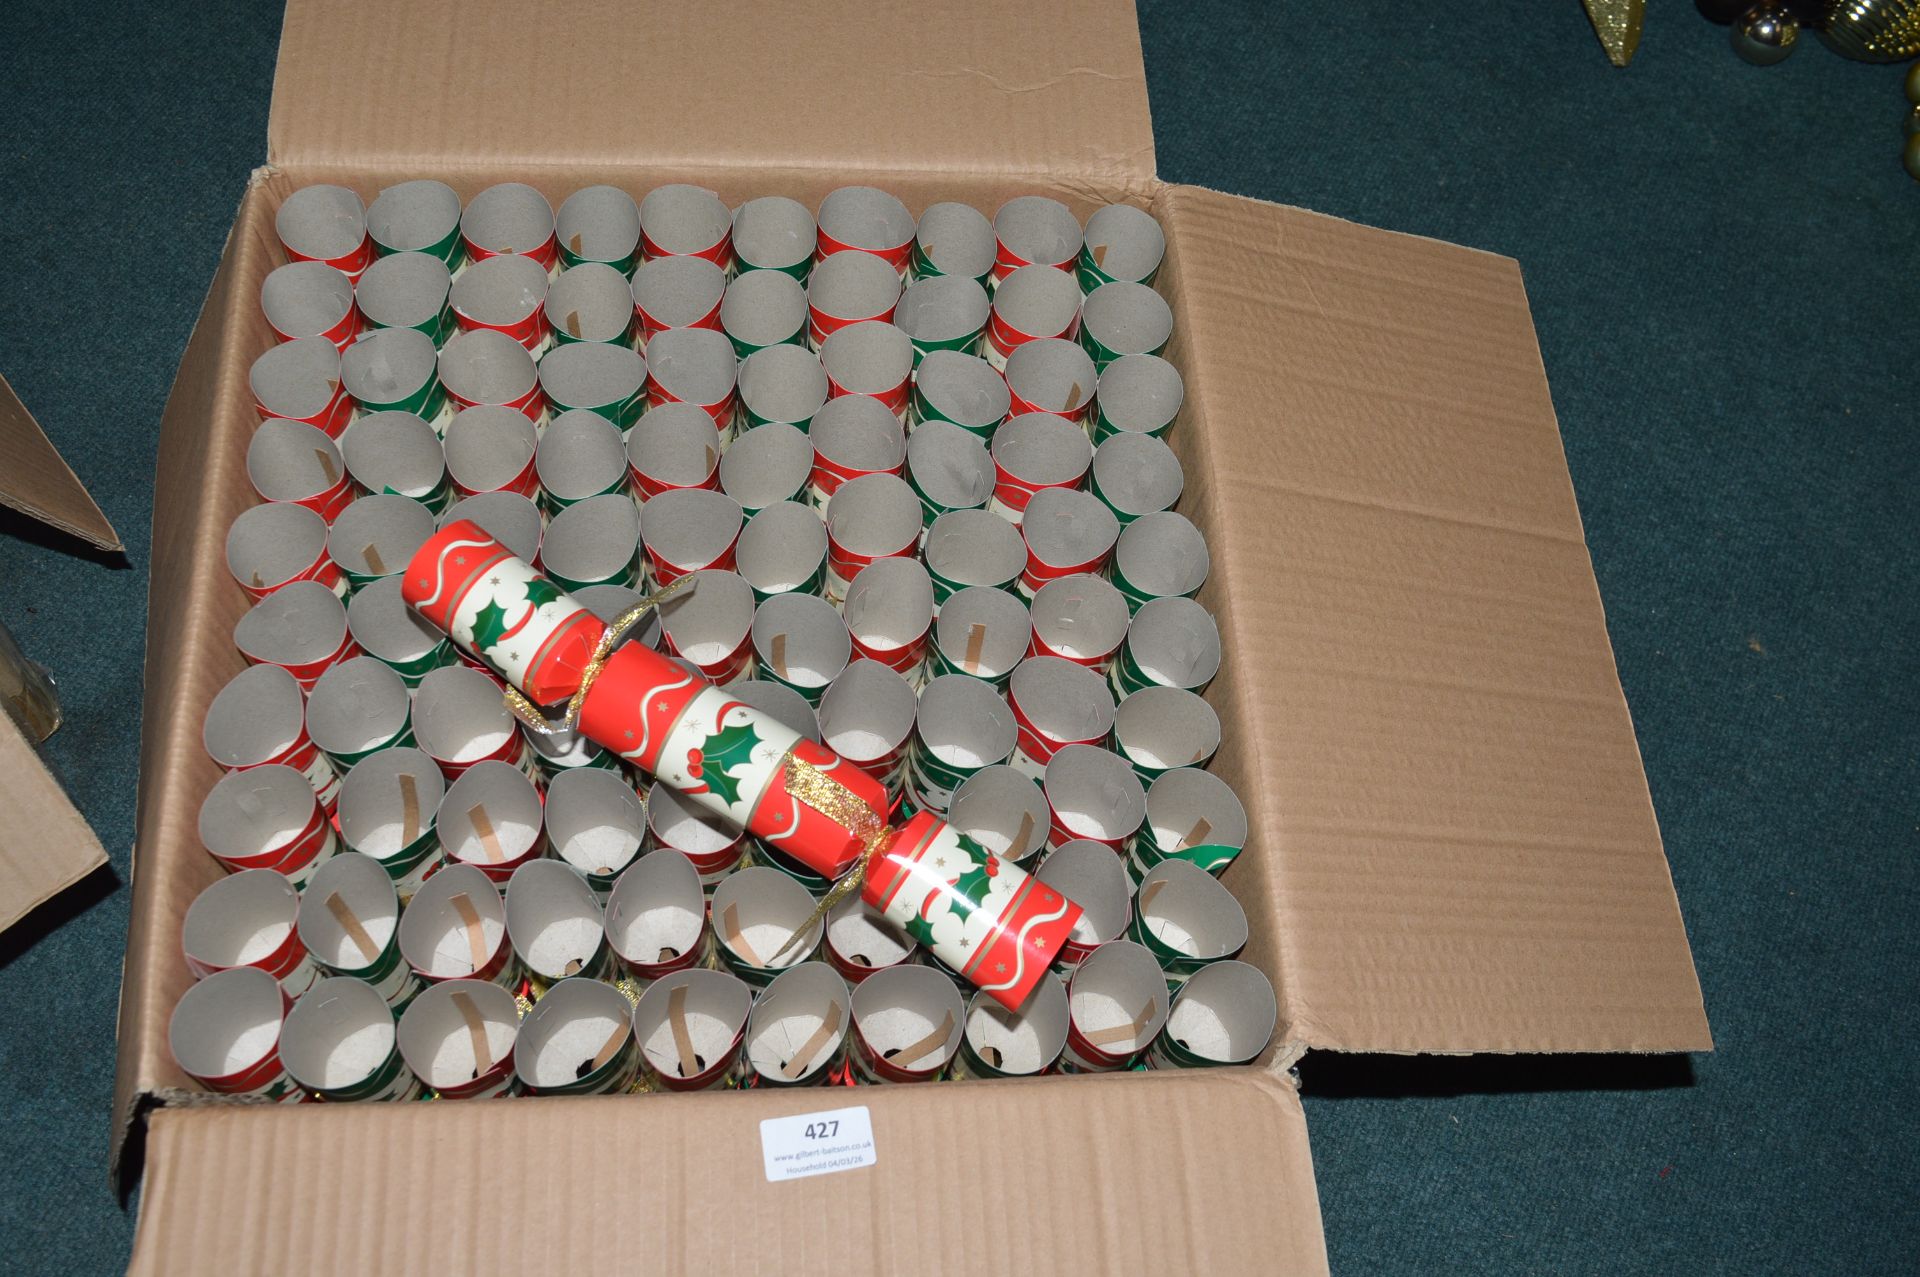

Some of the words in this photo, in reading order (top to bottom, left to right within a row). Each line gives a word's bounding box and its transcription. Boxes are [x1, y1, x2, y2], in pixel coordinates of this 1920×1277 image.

[805, 1120, 840, 1140] 427
[774, 1140, 872, 1162] www.gilbert-baitson.co.uk
[786, 1160, 827, 1175] Household
